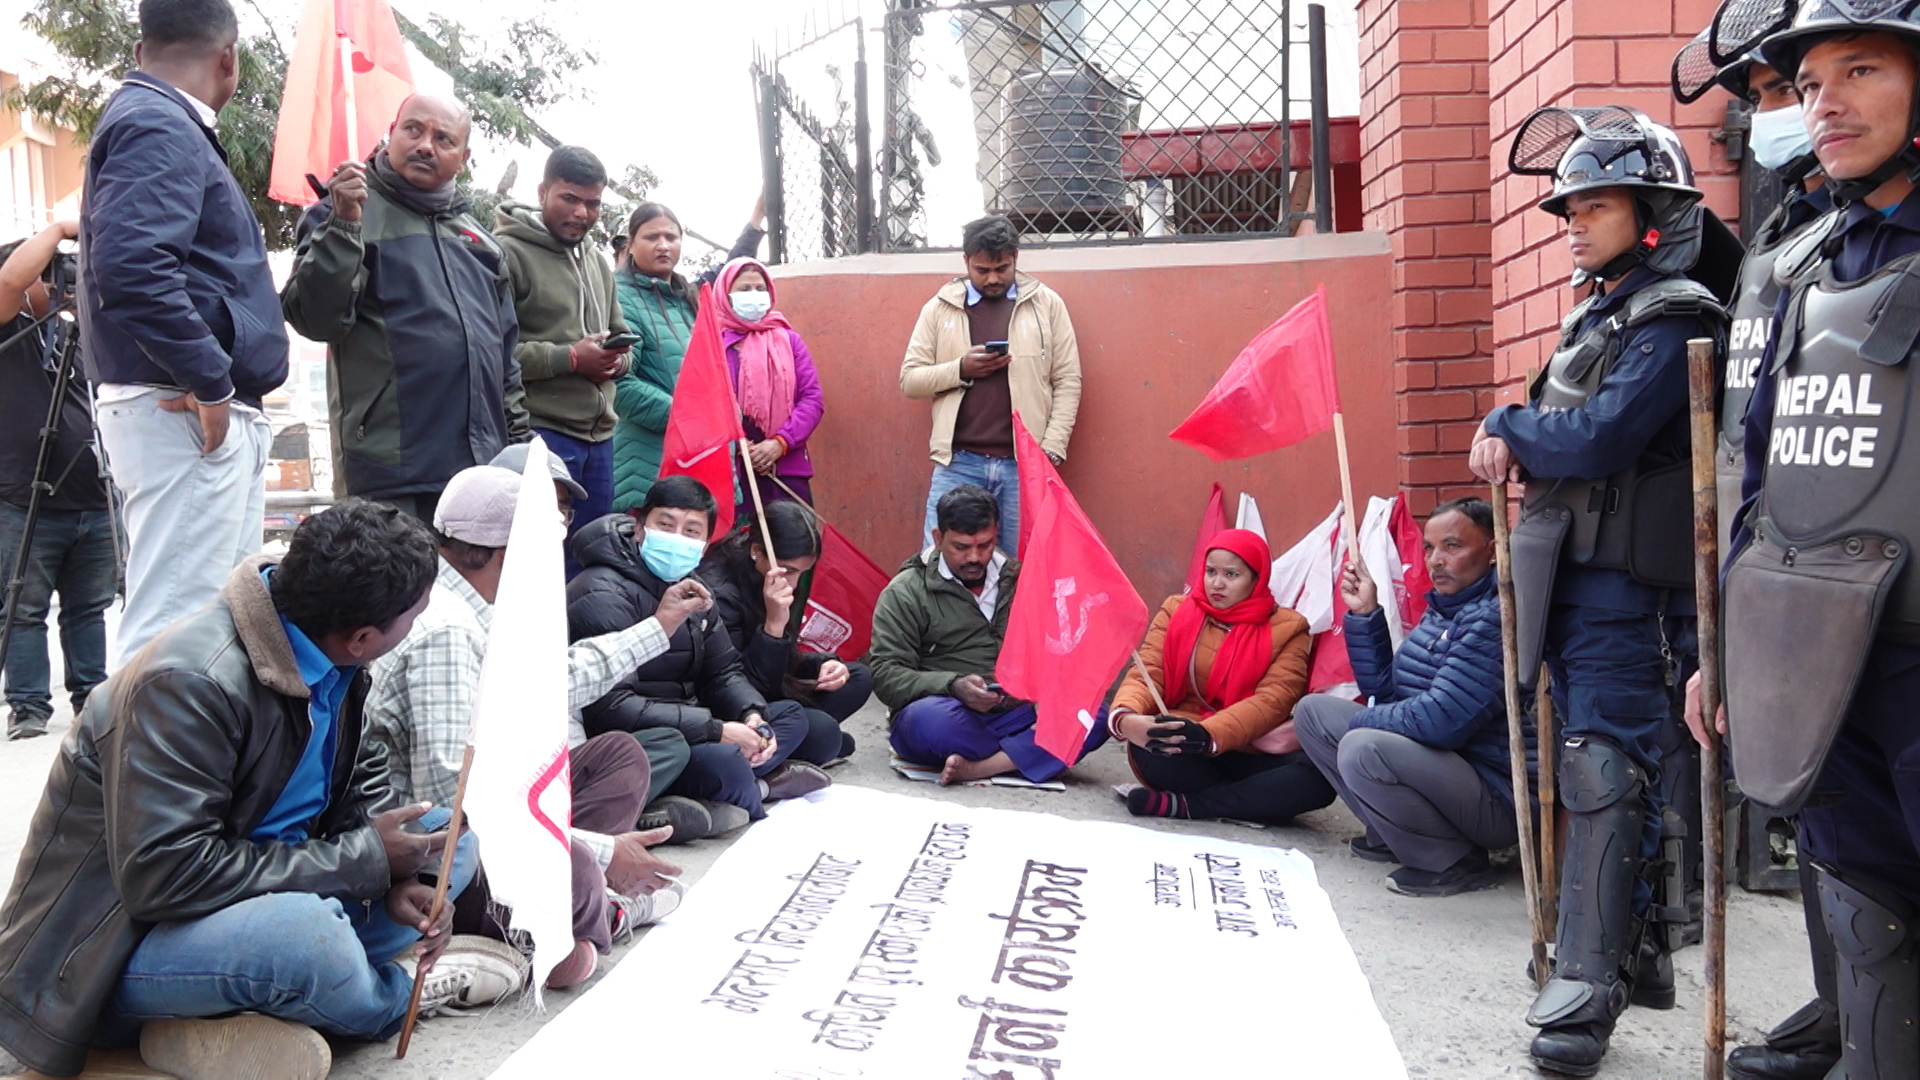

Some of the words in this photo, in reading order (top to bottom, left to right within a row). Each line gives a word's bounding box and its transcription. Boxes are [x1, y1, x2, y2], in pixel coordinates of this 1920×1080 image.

[1725, 357, 1762, 389] OLIC
[1776, 373, 1882, 417] NEPAL
[1769, 426, 1879, 468] POLICE
[987, 858, 1089, 992] कार्यक्रम
[700, 948, 801, 1014] भन्सार
[801, 988, 897, 1051] कथित
